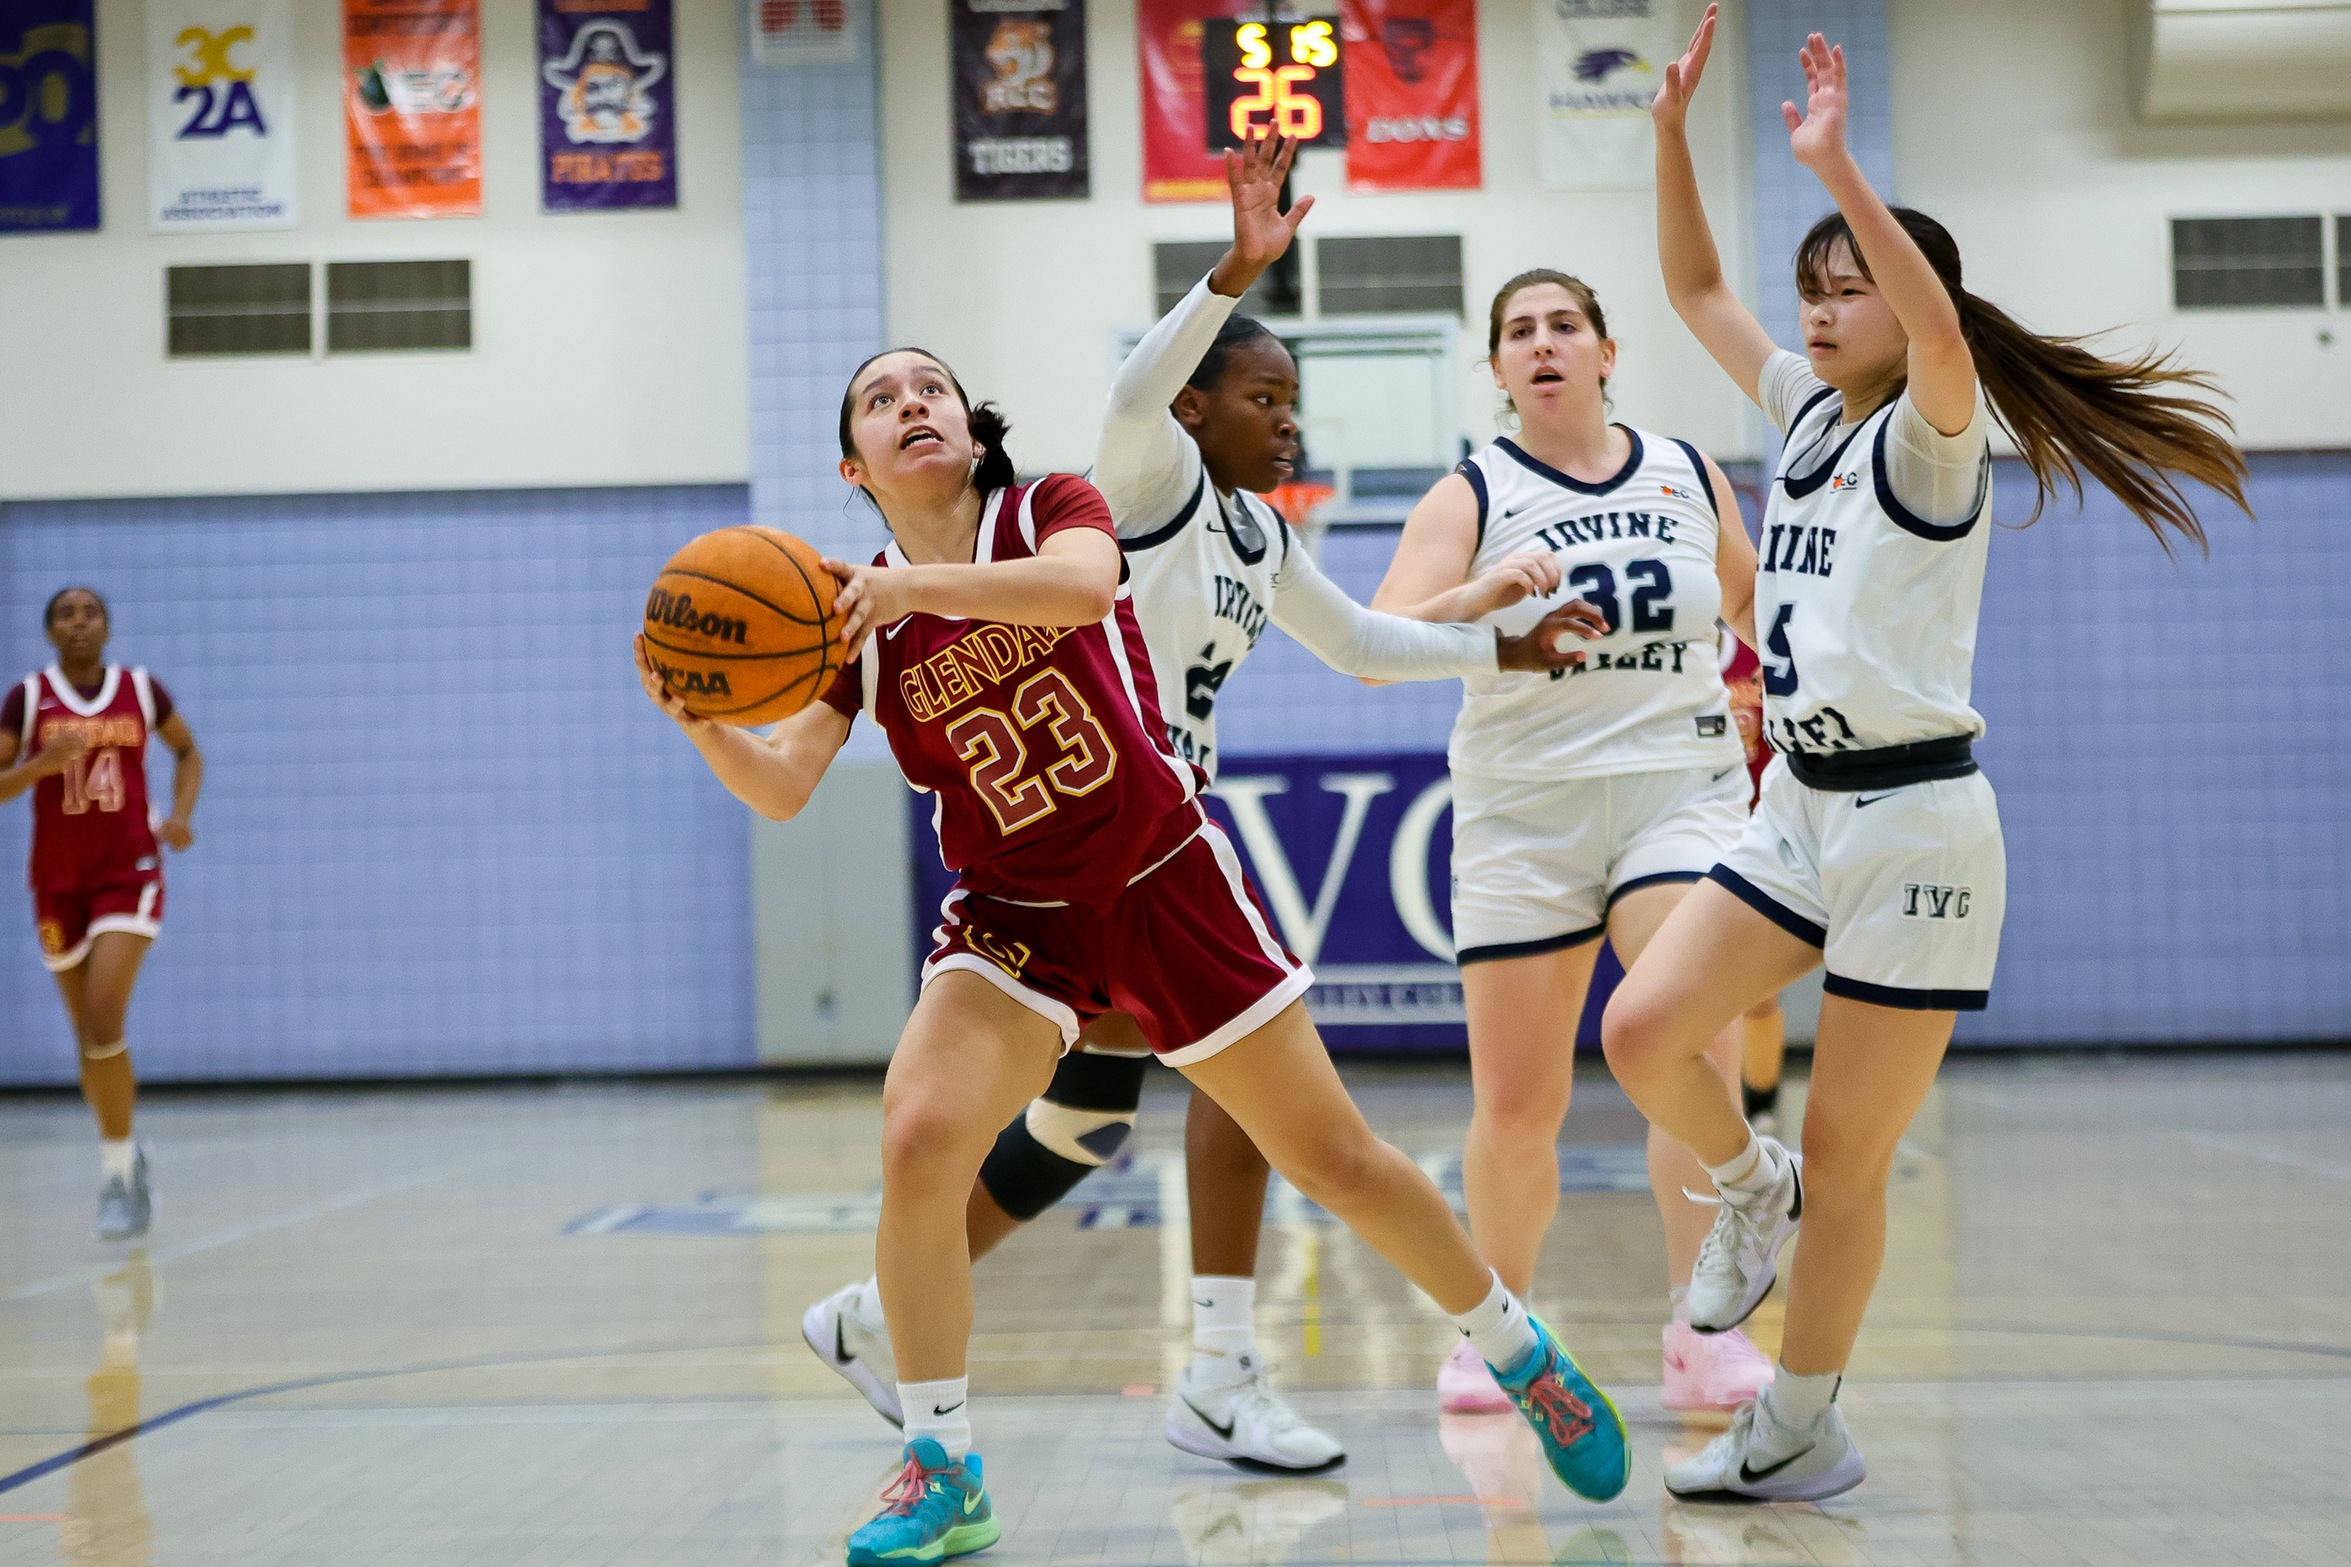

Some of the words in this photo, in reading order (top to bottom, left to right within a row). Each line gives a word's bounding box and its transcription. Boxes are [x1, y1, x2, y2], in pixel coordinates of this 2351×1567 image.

[172, 25, 256, 87] 3C
[173, 80, 268, 140] 2A
[1230, 65, 1323, 141] 26
[969, 137, 1073, 174] TIGERS
[1535, 511, 1679, 552] IRVINE
[646, 587, 748, 644] Wilson
[1568, 558, 1678, 638] 32
[900, 624, 1076, 722] GLENDA
[1550, 641, 1688, 681] LLEY
[945, 666, 1118, 836] 23
[61, 750, 126, 815] 14
[1202, 772, 1456, 965] VC
[1902, 883, 1972, 918] IVC
